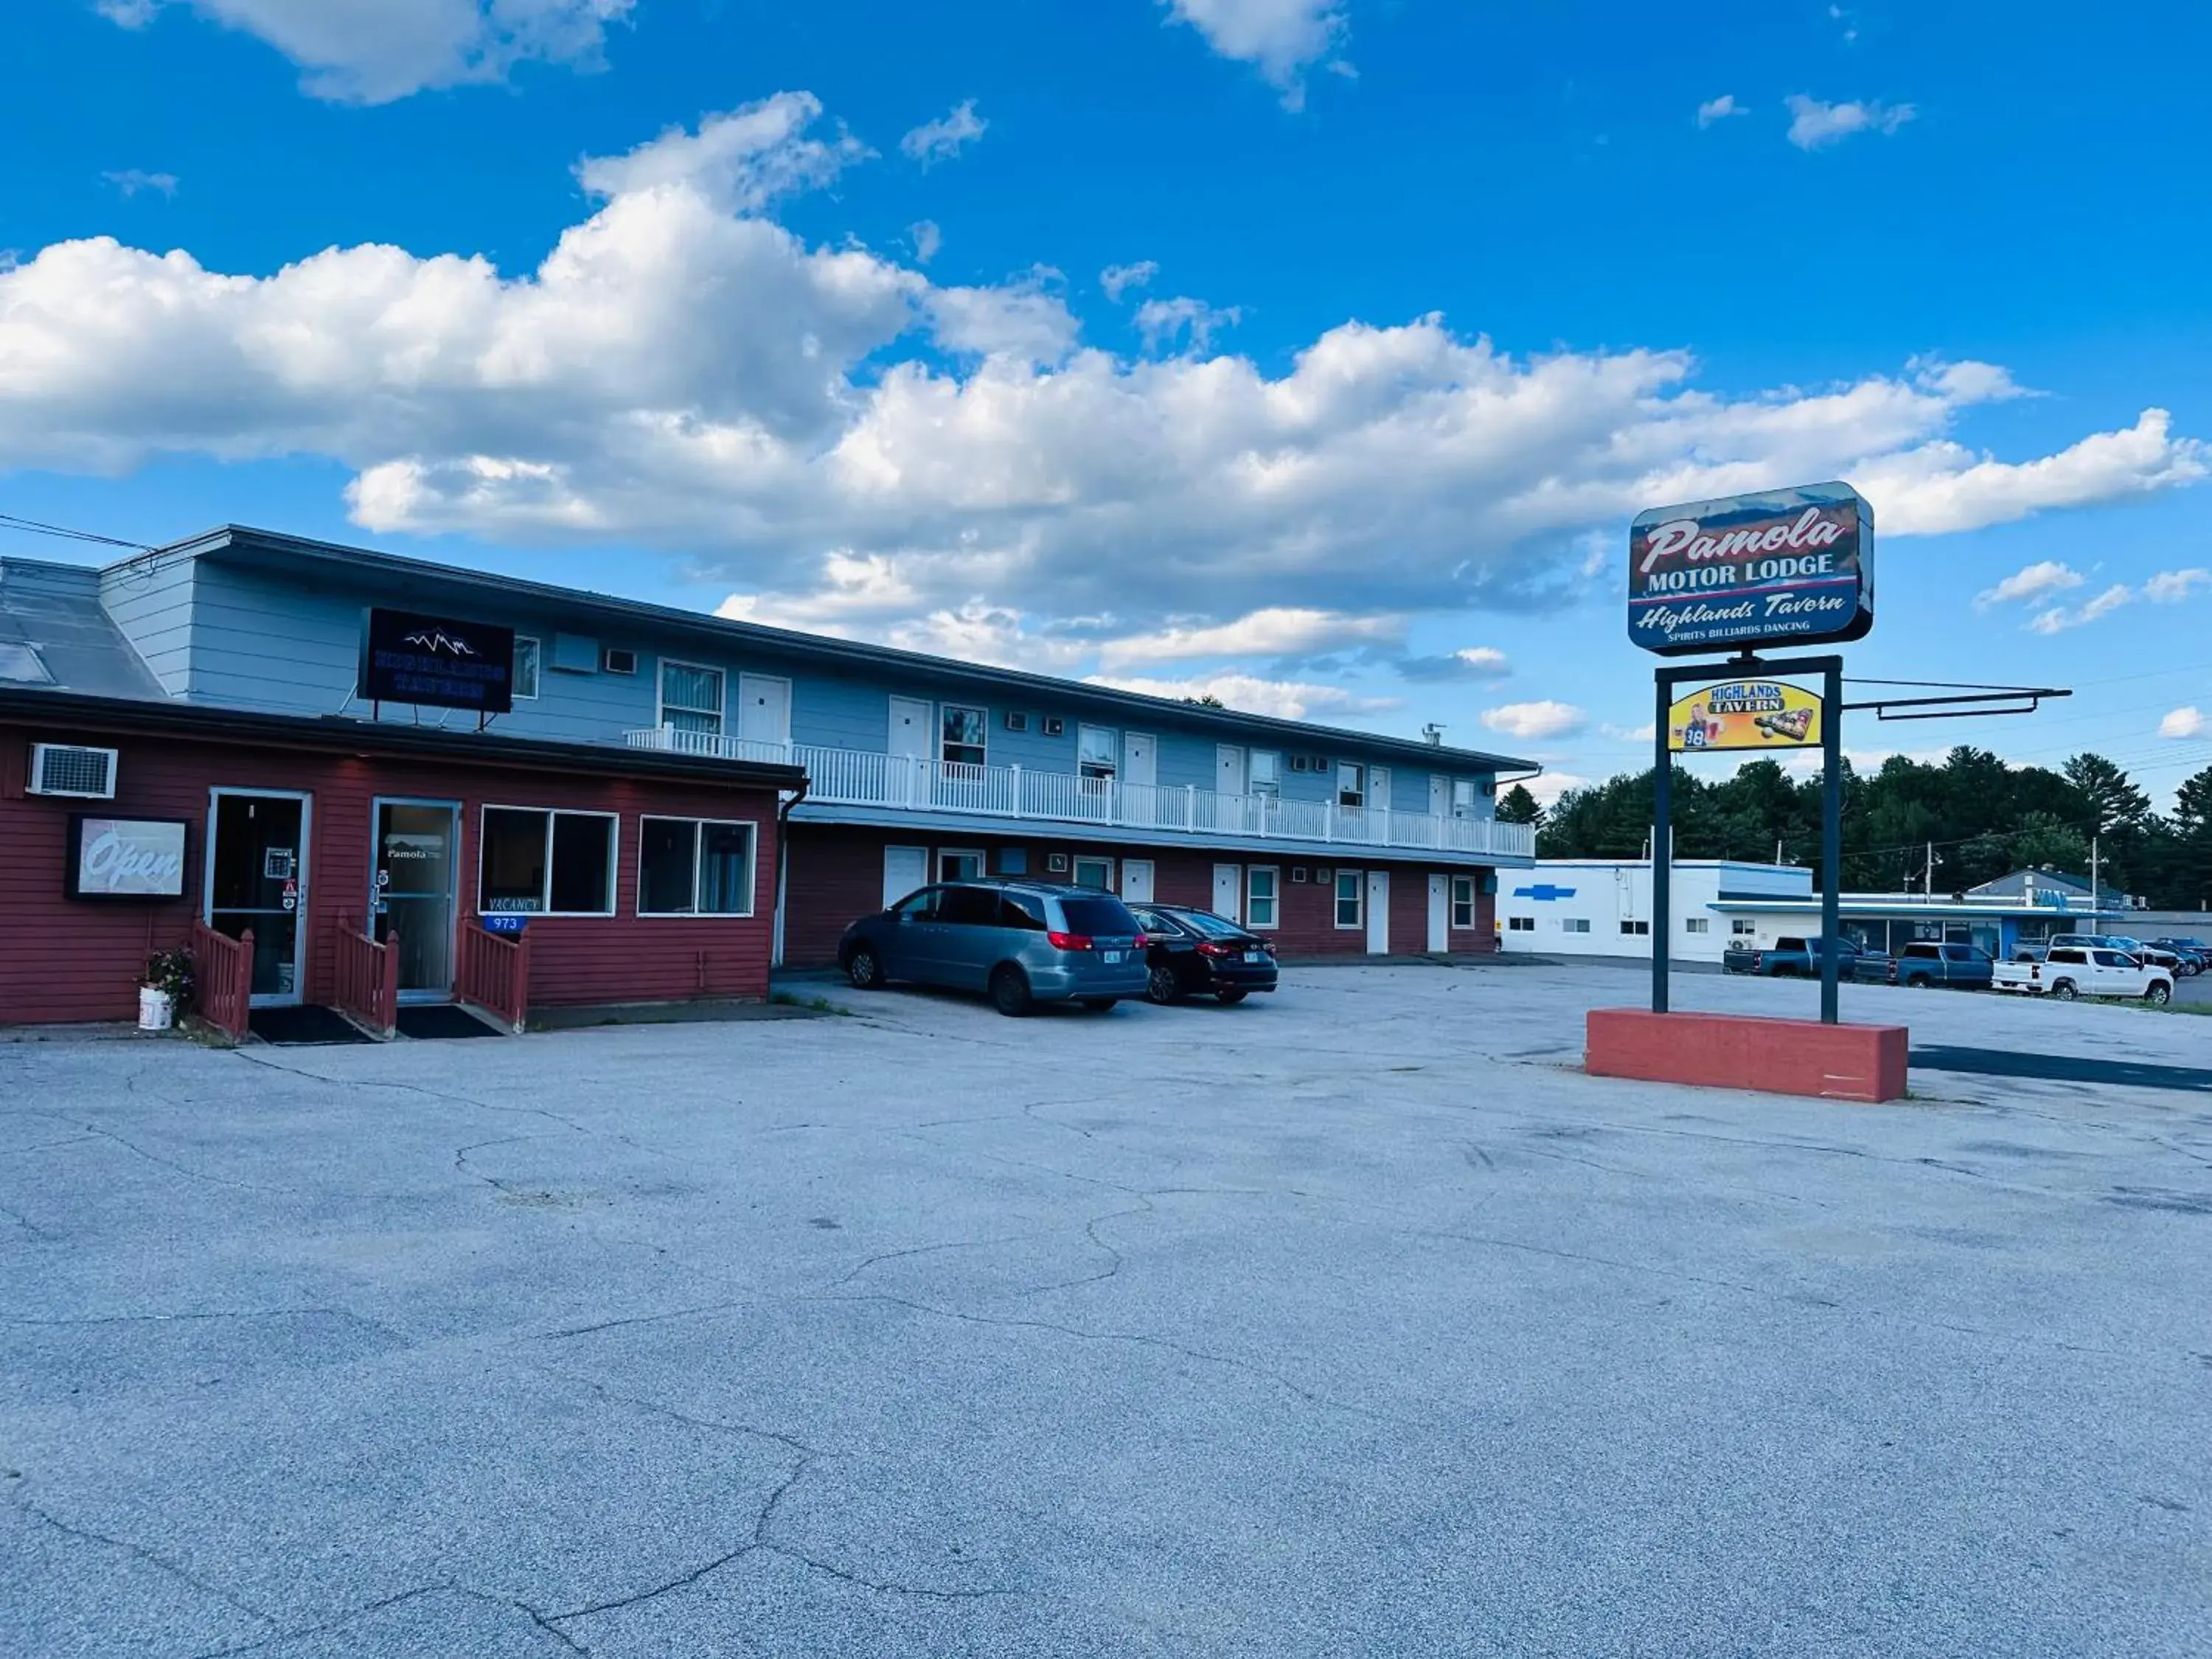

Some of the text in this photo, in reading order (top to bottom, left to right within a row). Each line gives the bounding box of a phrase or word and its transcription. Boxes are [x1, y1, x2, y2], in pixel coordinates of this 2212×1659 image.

[1639, 507, 1846, 573] Pamola
[1649, 554, 1834, 591] MOTOR LODGE
[1635, 592, 1846, 635] Highlands Tavern
[1668, 620, 1810, 642] SPIRITS BILLIARDS DANCING
[1711, 686, 1781, 700] HIGHLANDS
[1711, 700, 1781, 713] TAVERN
[86, 831, 179, 888] Open
[388, 849, 427, 859] Pamola
[493, 917, 517, 930] 973
